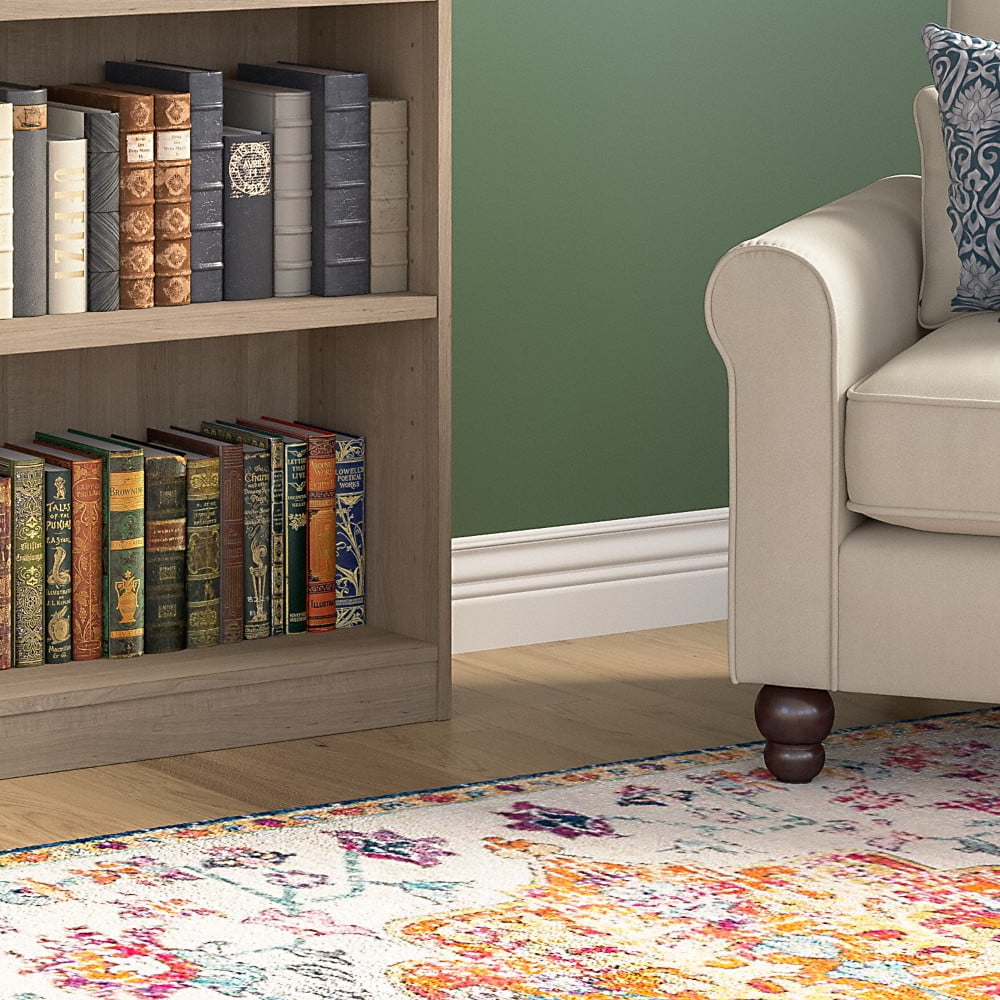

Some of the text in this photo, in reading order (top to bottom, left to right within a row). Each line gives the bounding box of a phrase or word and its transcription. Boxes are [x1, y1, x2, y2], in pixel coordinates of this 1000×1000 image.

[53, 167, 85, 280] UFFIZI
[340, 482, 361, 490] WORKS
[46, 501, 71, 512] TALES
